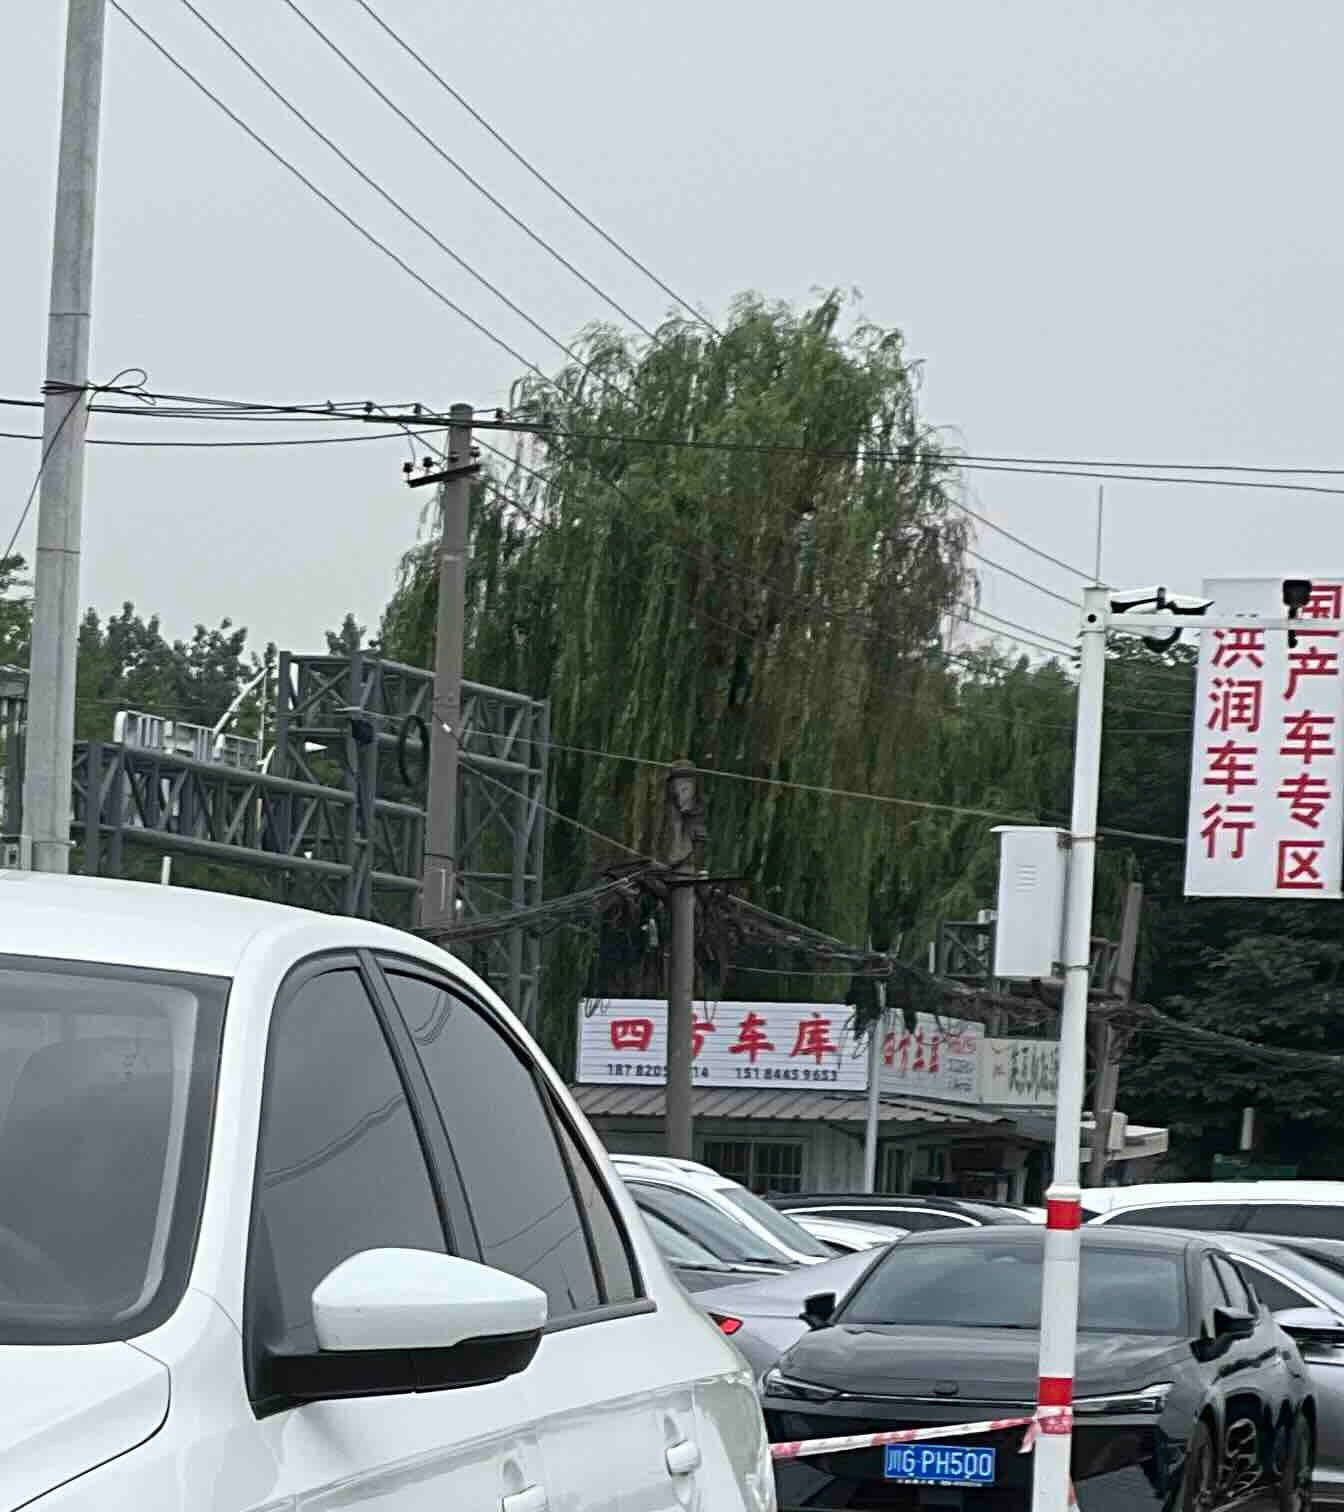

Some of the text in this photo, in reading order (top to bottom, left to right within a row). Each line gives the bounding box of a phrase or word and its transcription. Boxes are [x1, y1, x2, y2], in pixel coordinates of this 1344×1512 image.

[1200, 627, 1265, 859] 洪润车行
[1276, 584, 1342, 889] 国产车专区
